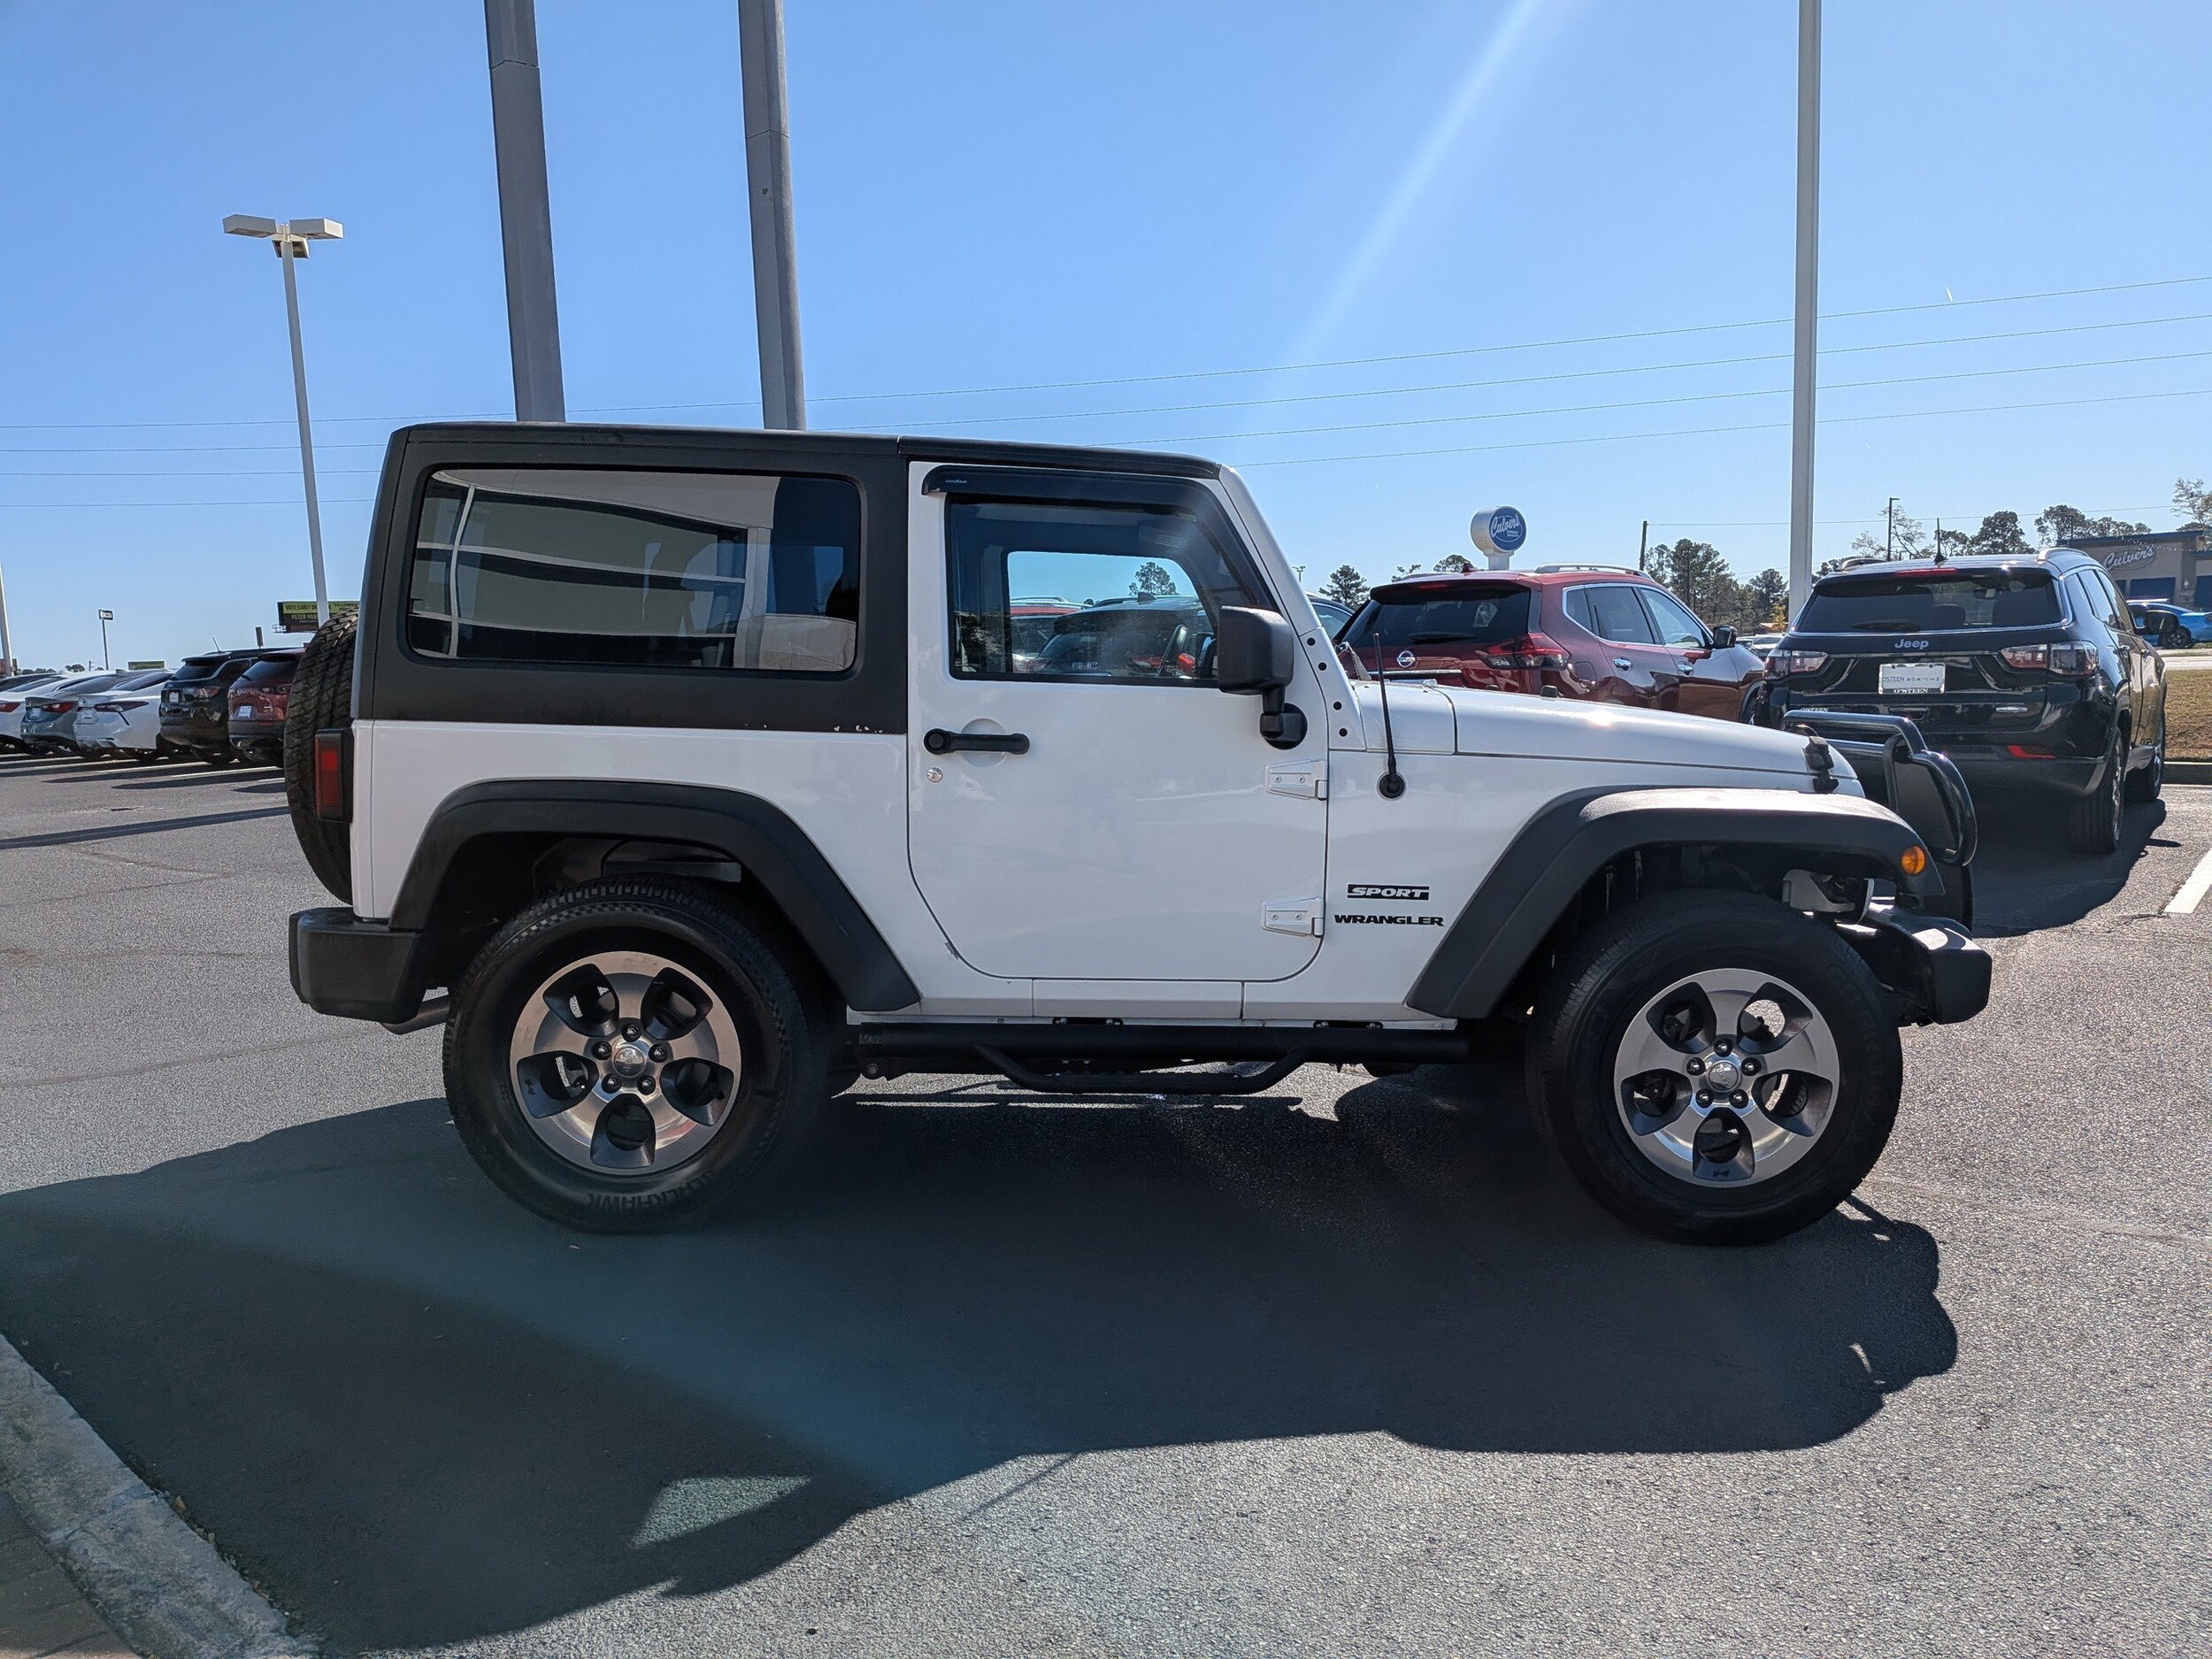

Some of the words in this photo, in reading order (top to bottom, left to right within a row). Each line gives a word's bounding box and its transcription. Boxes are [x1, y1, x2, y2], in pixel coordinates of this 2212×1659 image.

[2103, 544, 2154, 571] Culver's
[1894, 639, 1929, 649] Jeep
[1351, 887, 1429, 898] SPORT
[1334, 914, 1444, 926] WRANGLER
